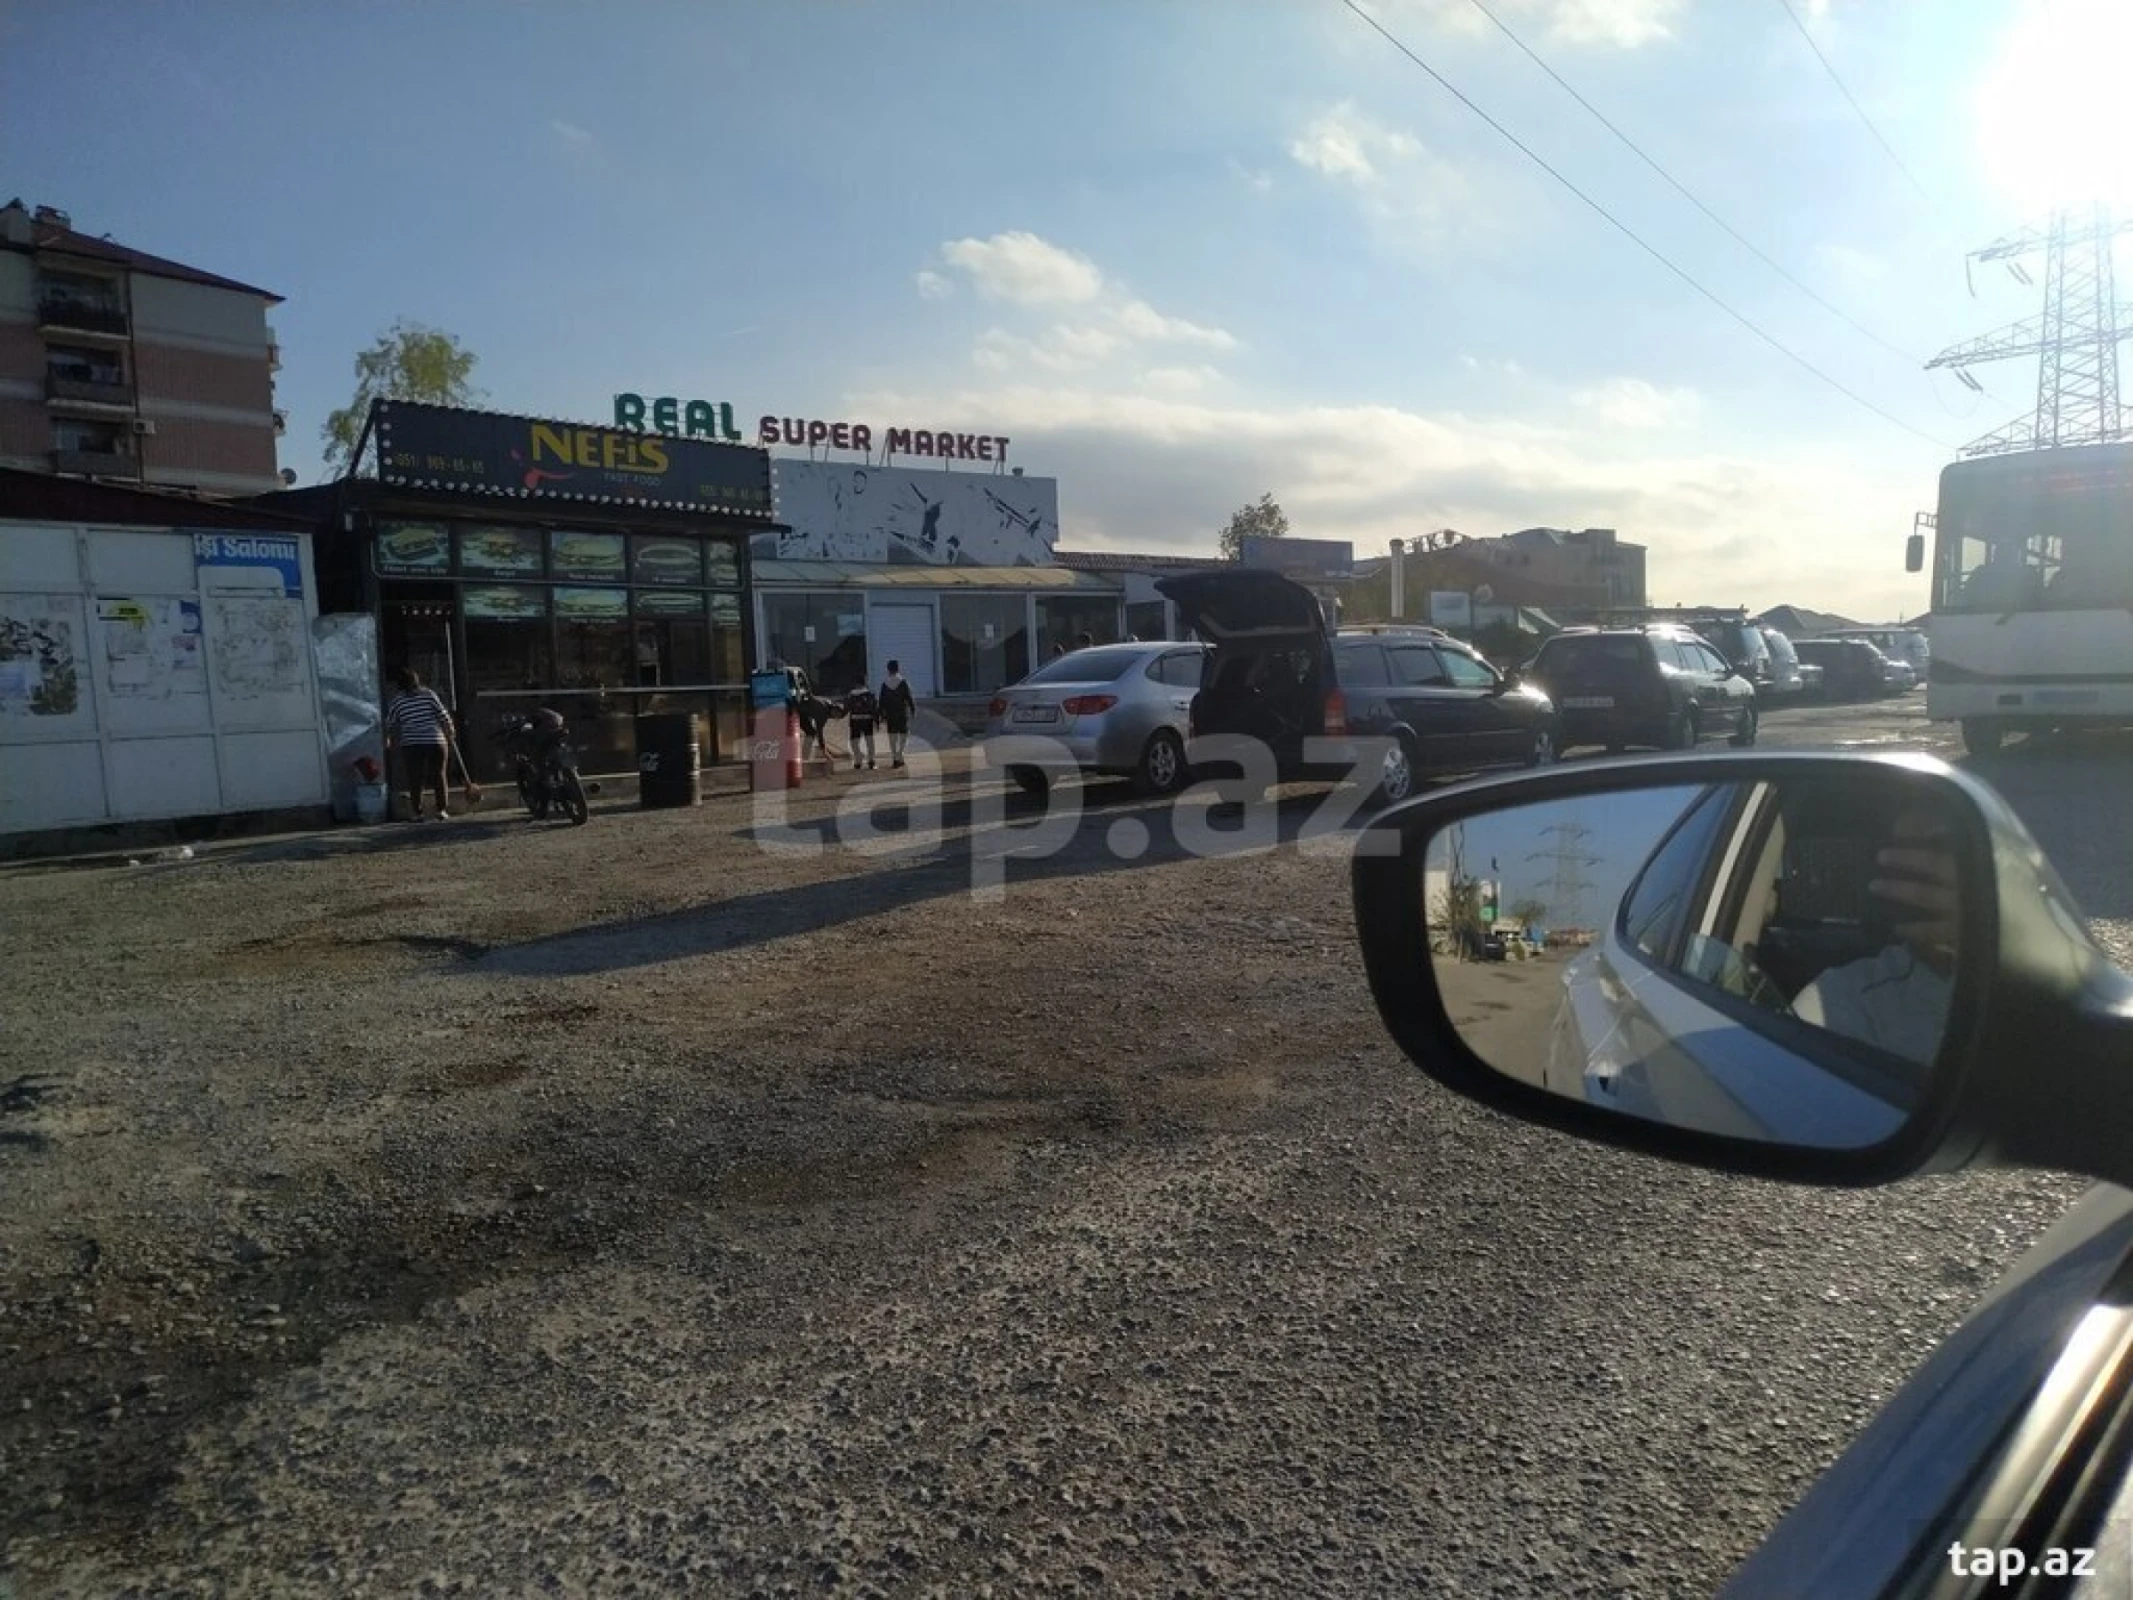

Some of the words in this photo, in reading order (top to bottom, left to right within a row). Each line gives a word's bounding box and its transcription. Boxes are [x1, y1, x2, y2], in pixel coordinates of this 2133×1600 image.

[614, 393, 742, 440] REAL
[760, 416, 872, 451] SUPER
[888, 427, 1010, 462] MARKET
